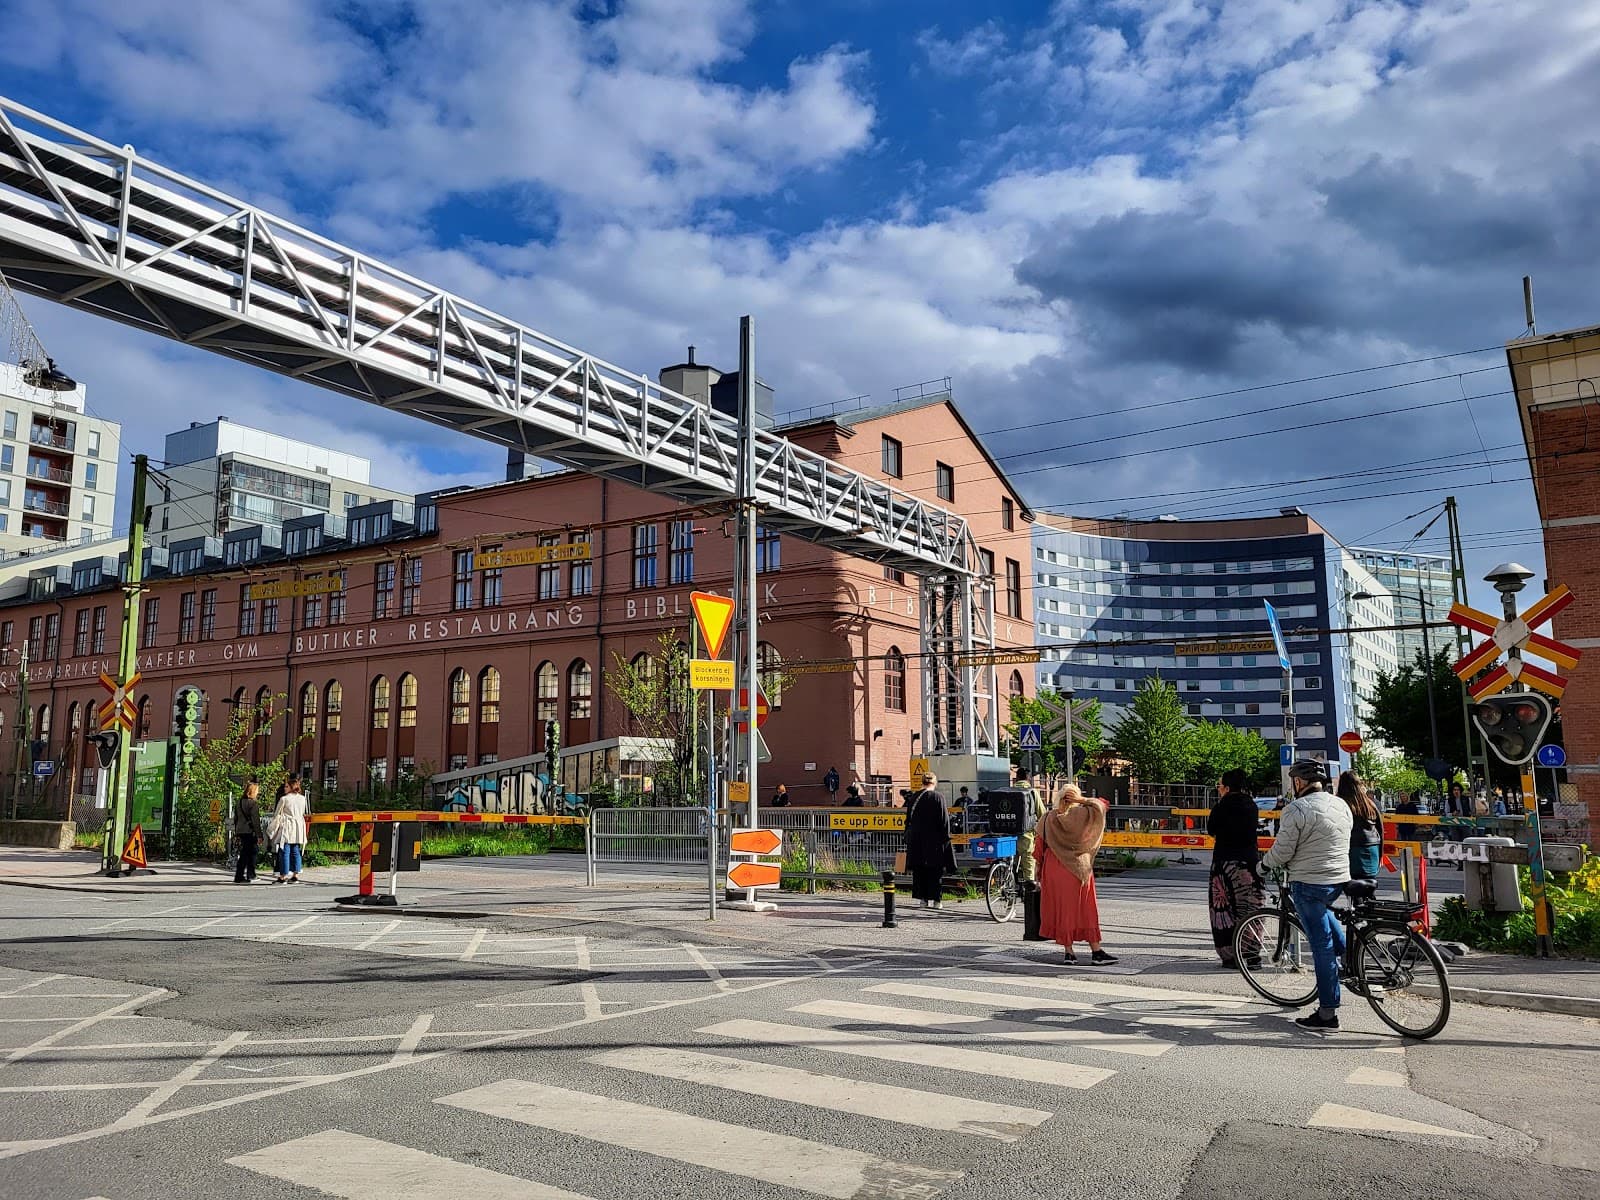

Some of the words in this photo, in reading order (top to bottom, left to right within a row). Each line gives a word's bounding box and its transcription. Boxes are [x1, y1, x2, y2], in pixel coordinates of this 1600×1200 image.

[223, 643, 258, 660] GYM
[296, 628, 377, 652] BUTIKER
[408, 605, 583, 640] RESTAURANG
[695, 675, 730, 683] korsningen
[833, 818, 846, 826] se
[849, 818, 869, 828] upp
[873, 816, 888, 826] för
